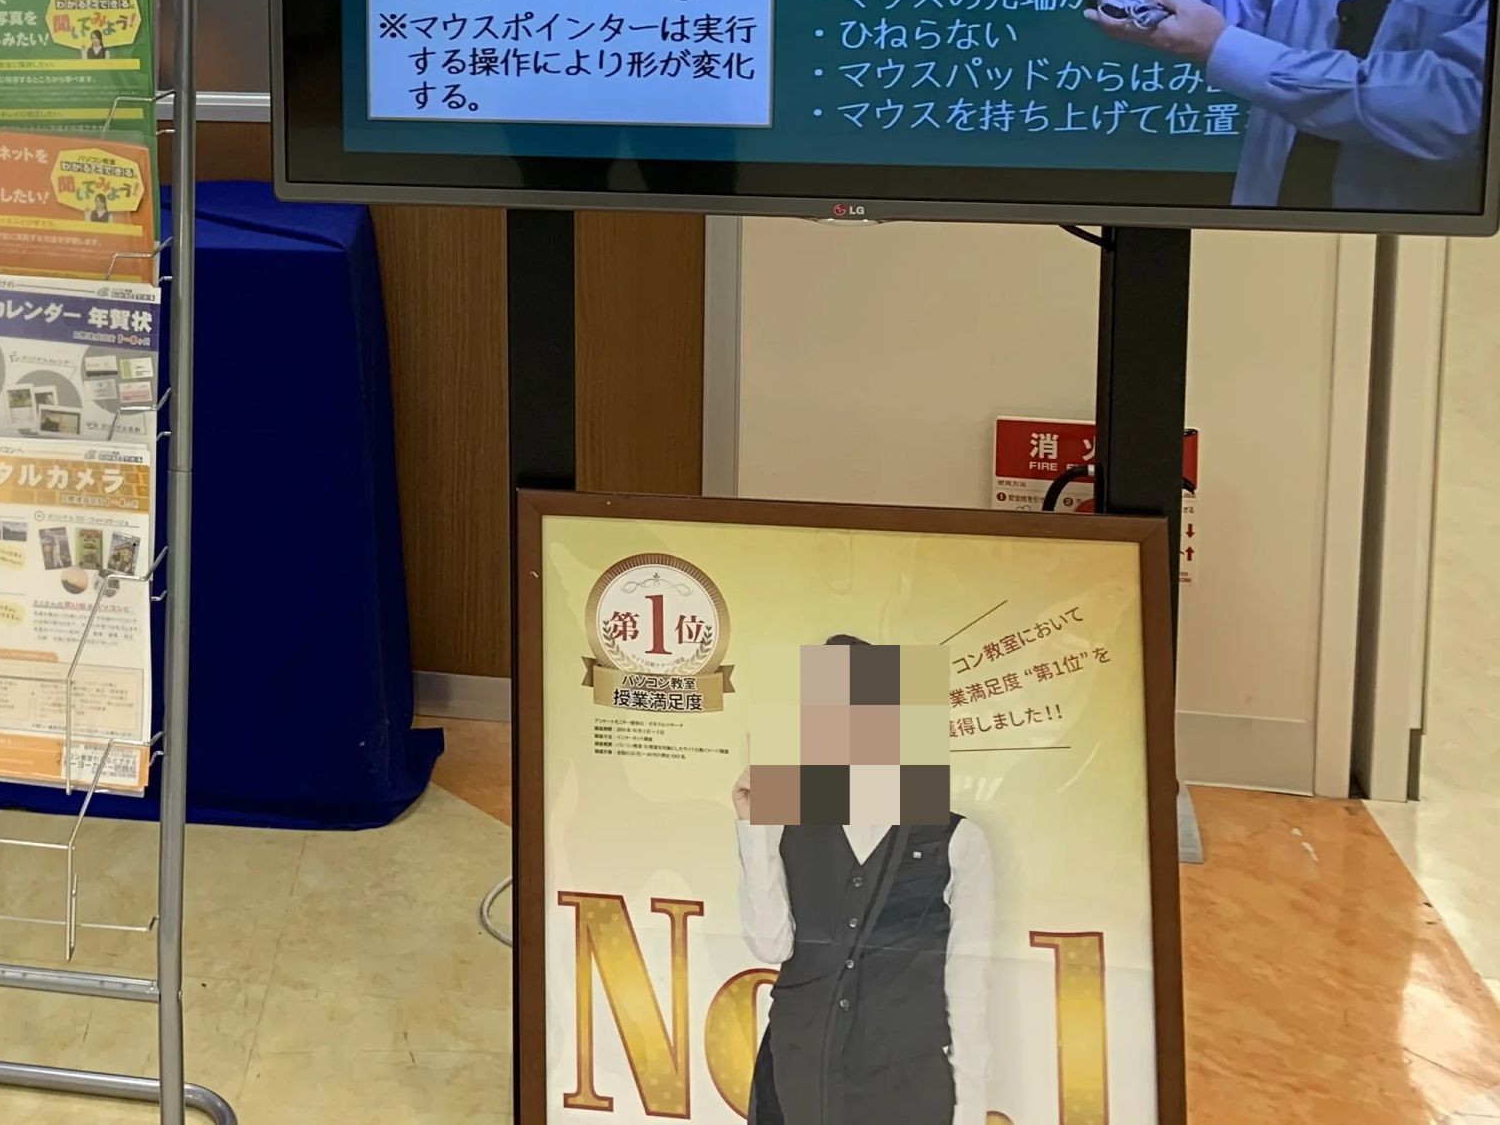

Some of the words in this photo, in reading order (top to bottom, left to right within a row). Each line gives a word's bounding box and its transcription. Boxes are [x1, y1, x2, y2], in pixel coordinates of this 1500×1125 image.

[408, 46, 756, 80] する操作により形が変化
[408, 82, 480, 113] する。
[837, 98, 1251, 136] マウスを持ち上げて位置
[849, 205, 865, 216] LG
[87, 307, 153, 333] 年賀状
[1028, 460, 1059, 472] FIRE
[608, 594, 706, 655] 第1位
[621, 675, 697, 690] パソコン教室
[613, 689, 704, 712] 授業満足度
